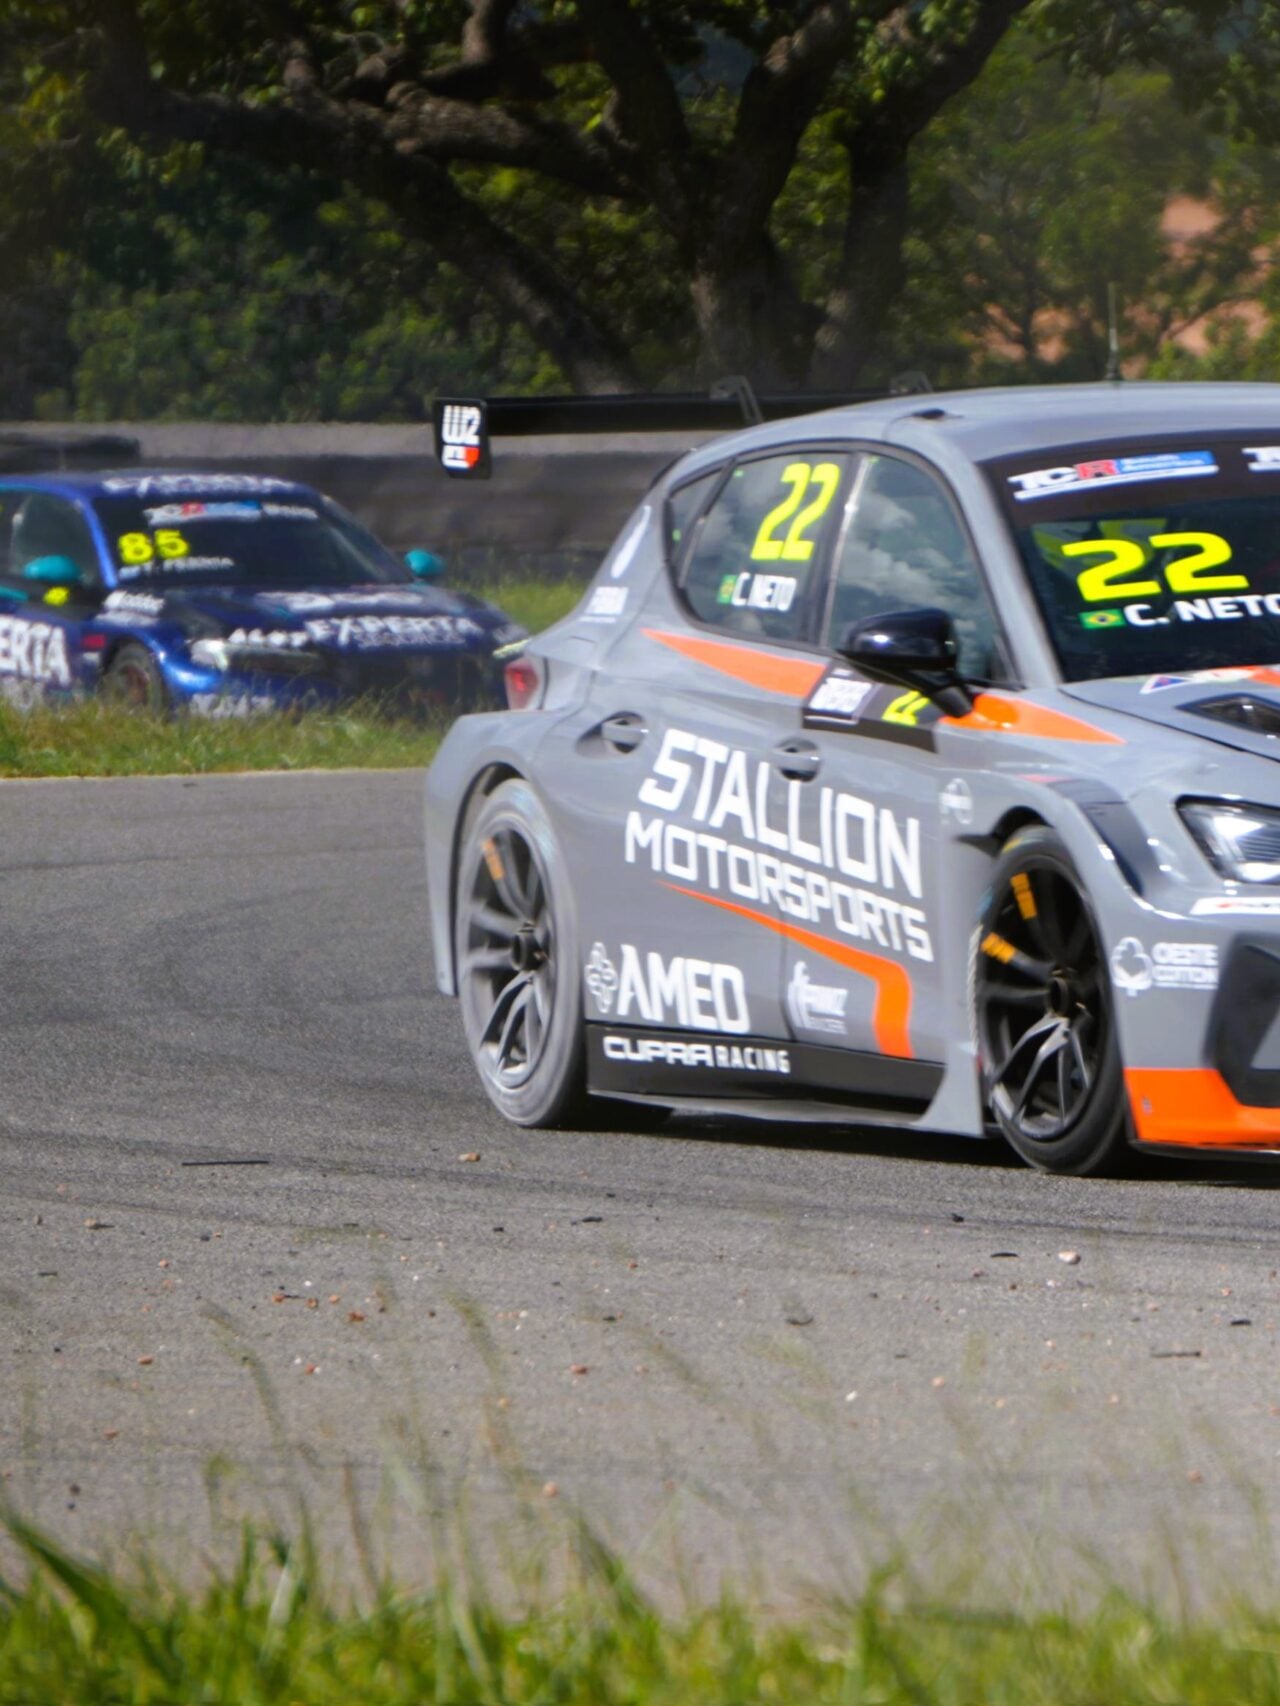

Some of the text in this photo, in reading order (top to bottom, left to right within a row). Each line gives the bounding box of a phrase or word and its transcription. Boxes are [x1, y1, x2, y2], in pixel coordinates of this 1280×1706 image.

[751, 463, 840, 560] 22
[118, 528, 191, 565] 85
[1062, 532, 1249, 601] 22
[304, 616, 484, 646] EXPERTA
[1124, 604, 1168, 628] C.
[638, 728, 923, 898] STALLION
[625, 811, 934, 962] MOTORSPORTS
[616, 944, 750, 1035] AMED
[603, 1036, 791, 1074] CUPRA RACING
